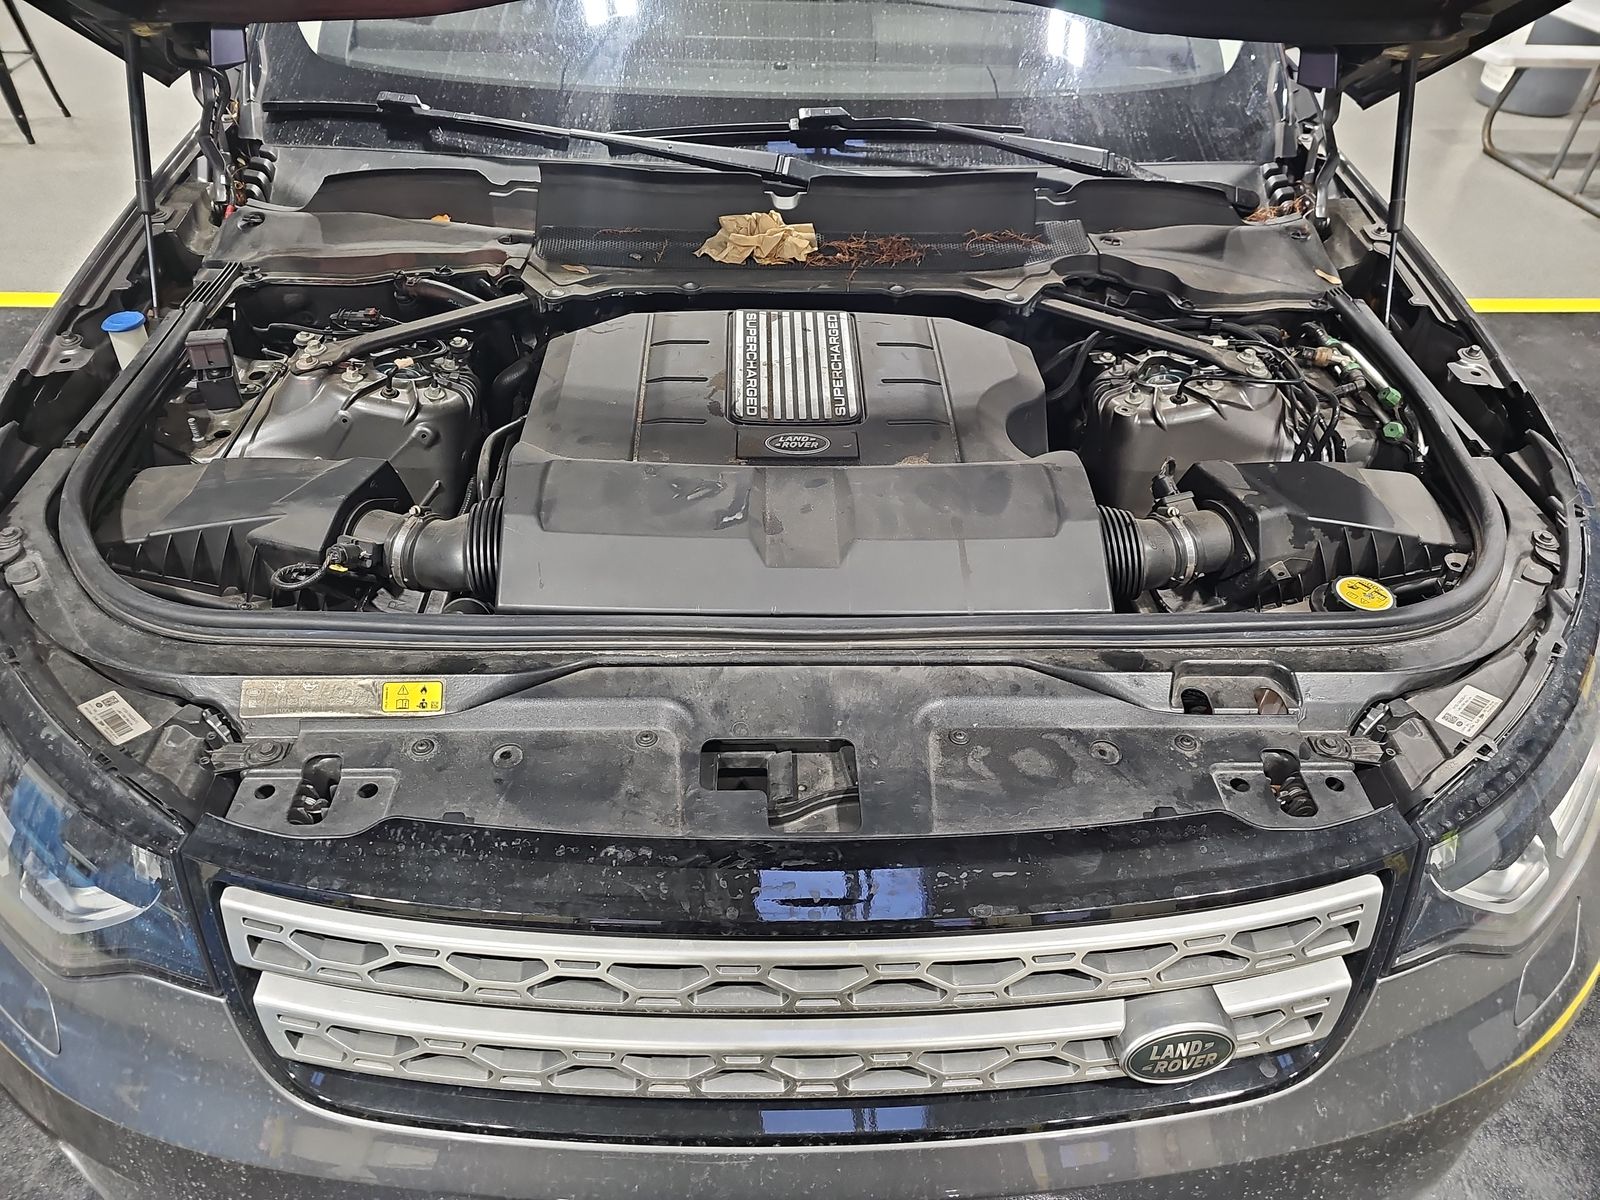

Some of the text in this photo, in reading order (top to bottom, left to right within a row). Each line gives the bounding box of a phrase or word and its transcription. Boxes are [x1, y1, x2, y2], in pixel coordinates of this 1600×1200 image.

[746, 313, 758, 416] SUPERCHARGED
[827, 314, 845, 416] SUPERCHARGED
[1150, 1040, 1202, 1060] LAND
[1154, 1052, 1217, 1073] ROVER
